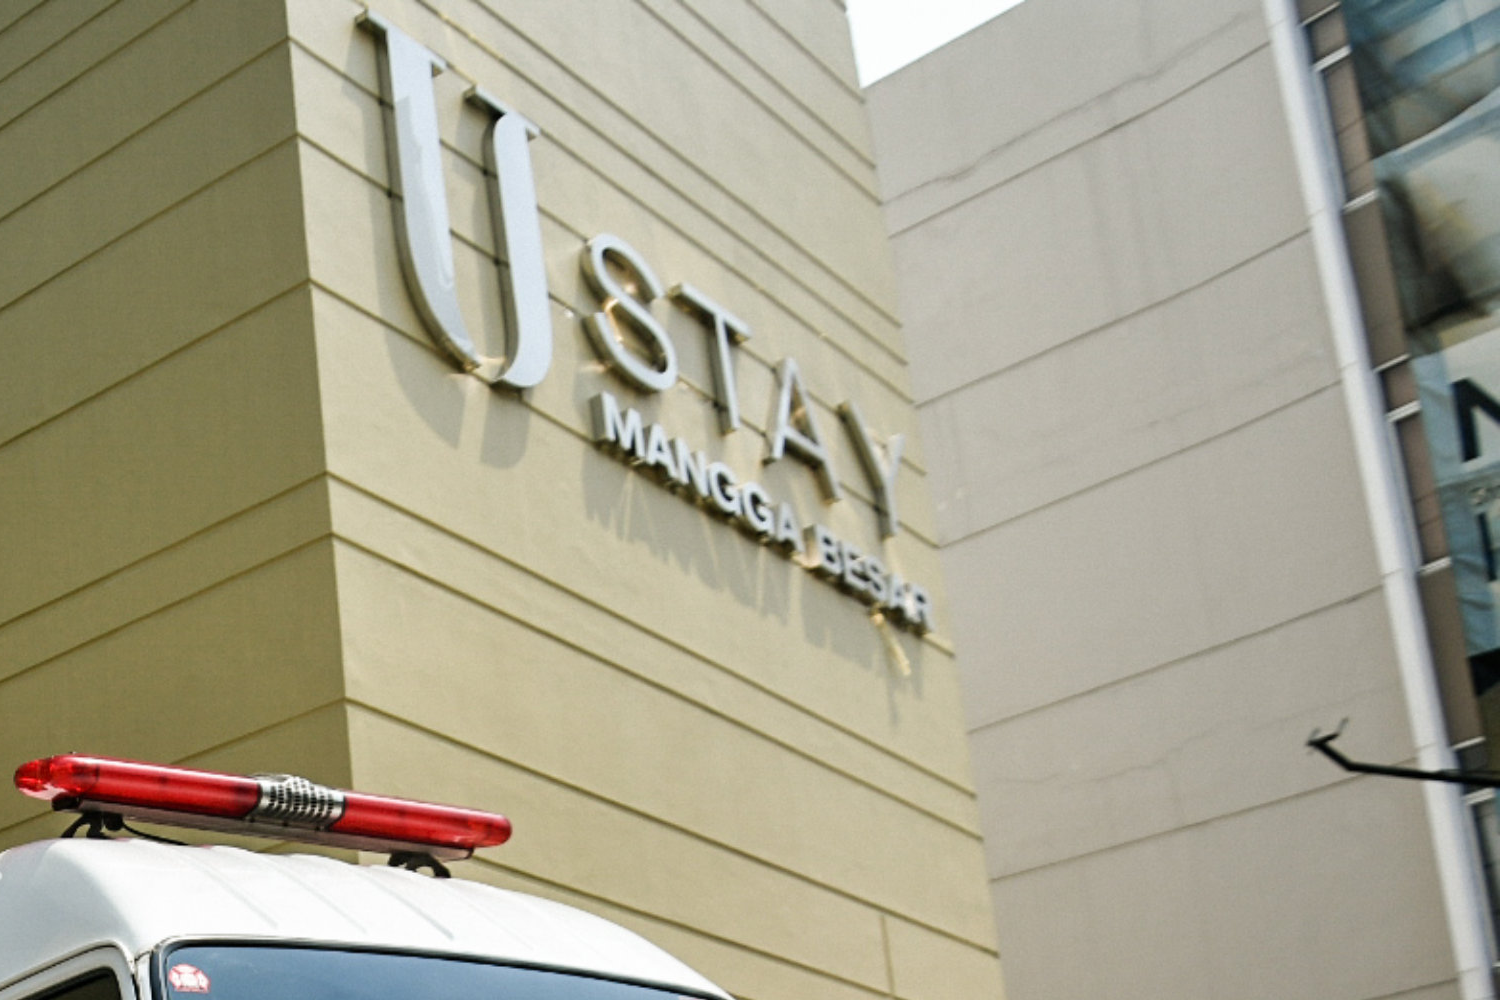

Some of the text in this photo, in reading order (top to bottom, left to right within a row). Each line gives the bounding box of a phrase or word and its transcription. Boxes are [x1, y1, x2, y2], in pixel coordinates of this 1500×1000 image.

[354, 8, 904, 538] U STAY
[590, 391, 934, 634] MANGGA BESAR
